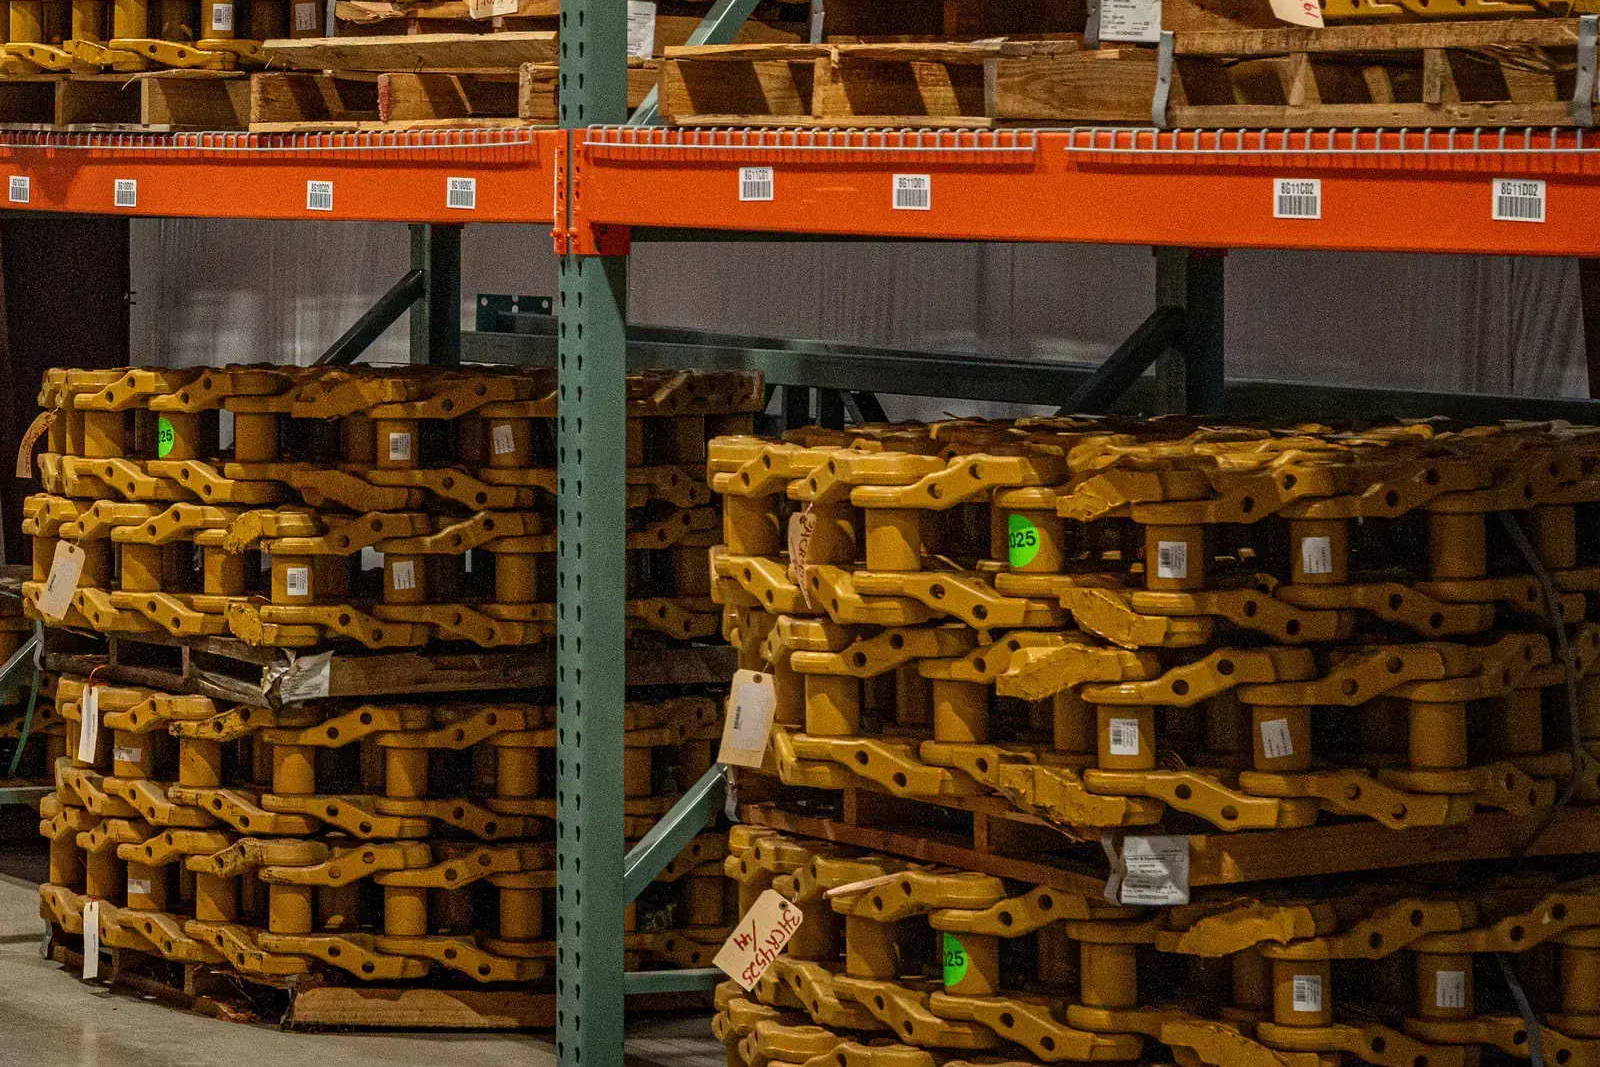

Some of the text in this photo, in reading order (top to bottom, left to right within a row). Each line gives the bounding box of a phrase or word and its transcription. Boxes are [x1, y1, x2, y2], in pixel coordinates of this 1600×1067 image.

[745, 169, 768, 180] 8G11C01
[899, 177, 925, 188] 8G11D01
[1281, 182, 1314, 194] 8G11C02
[1501, 182, 1539, 196] 8G11D02
[158, 429, 173, 442] 25
[1009, 530, 1036, 548] 025
[742, 910, 800, 985] 34CR4525
[944, 951, 963, 967] 025
